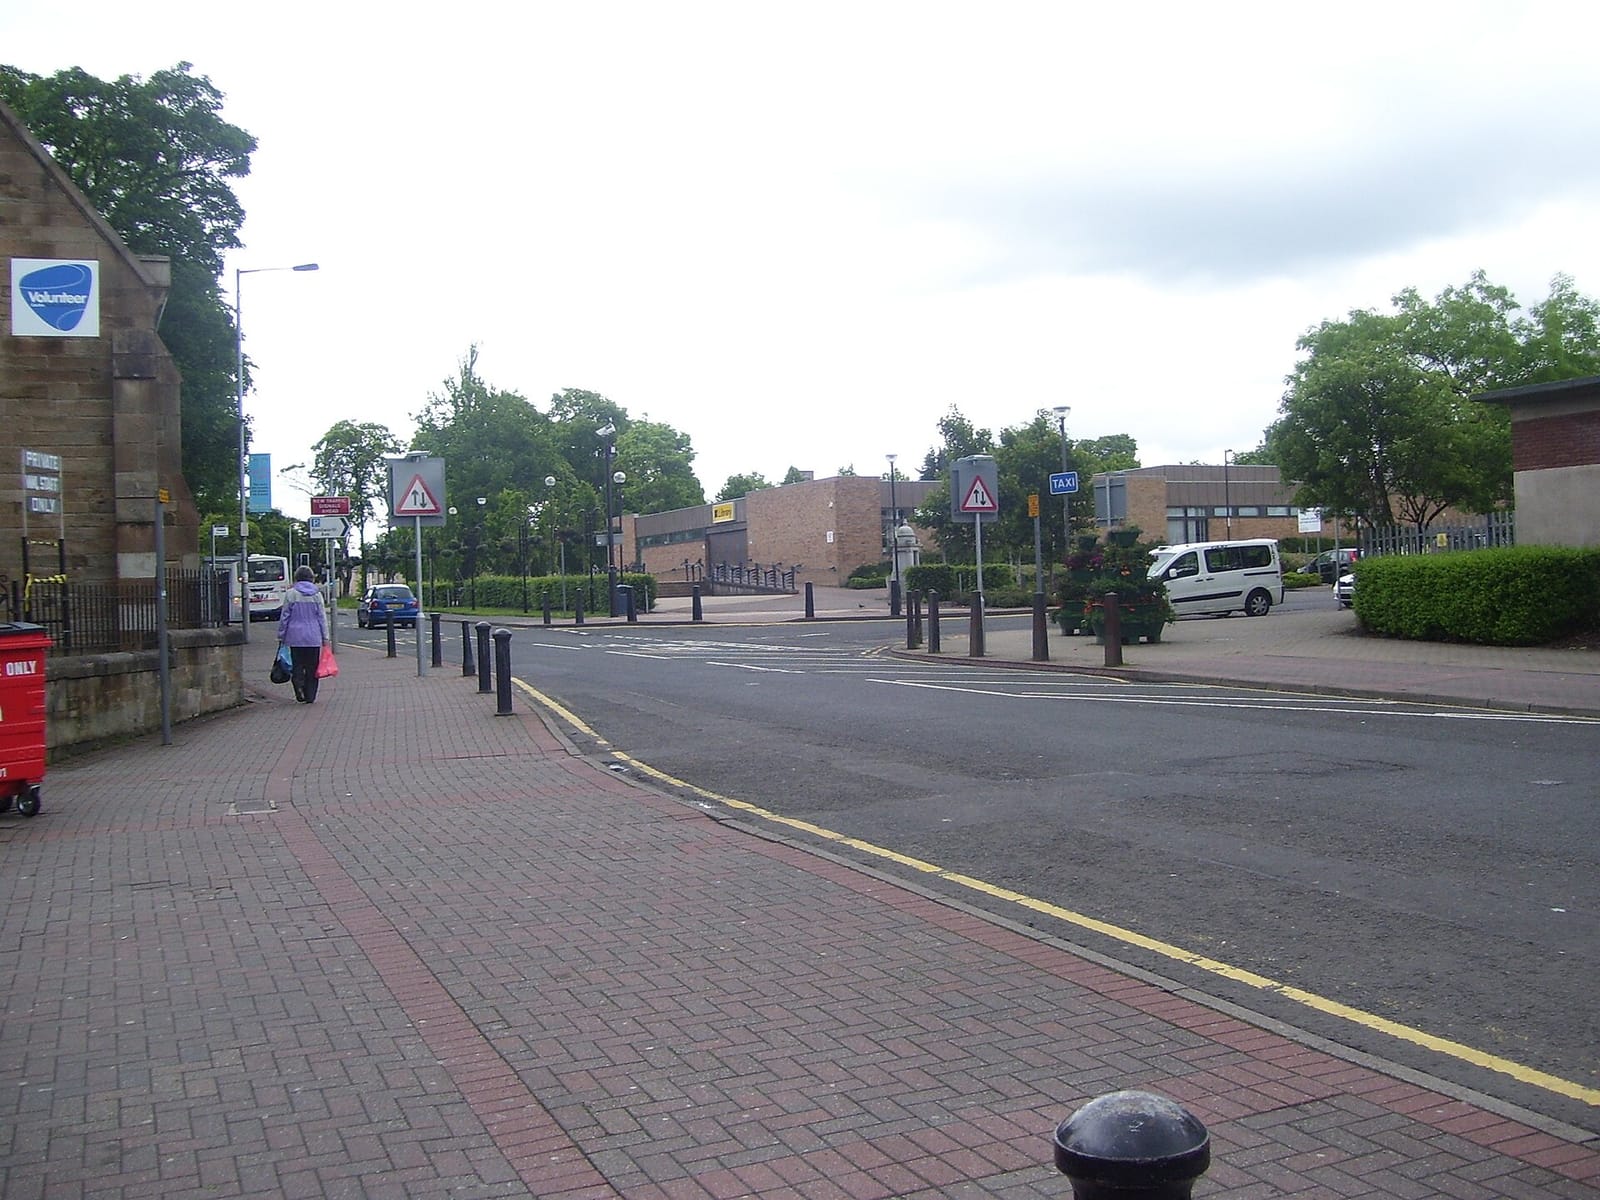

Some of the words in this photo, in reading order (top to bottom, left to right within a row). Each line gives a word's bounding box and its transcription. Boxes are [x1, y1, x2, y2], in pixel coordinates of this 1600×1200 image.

[28, 291, 87, 304] Volunteer
[26, 452, 58, 470] PRIVATE
[1052, 478, 1075, 489] TAXI
[31, 497, 55, 512] ONLY
[5, 660, 37, 676] ONLY
